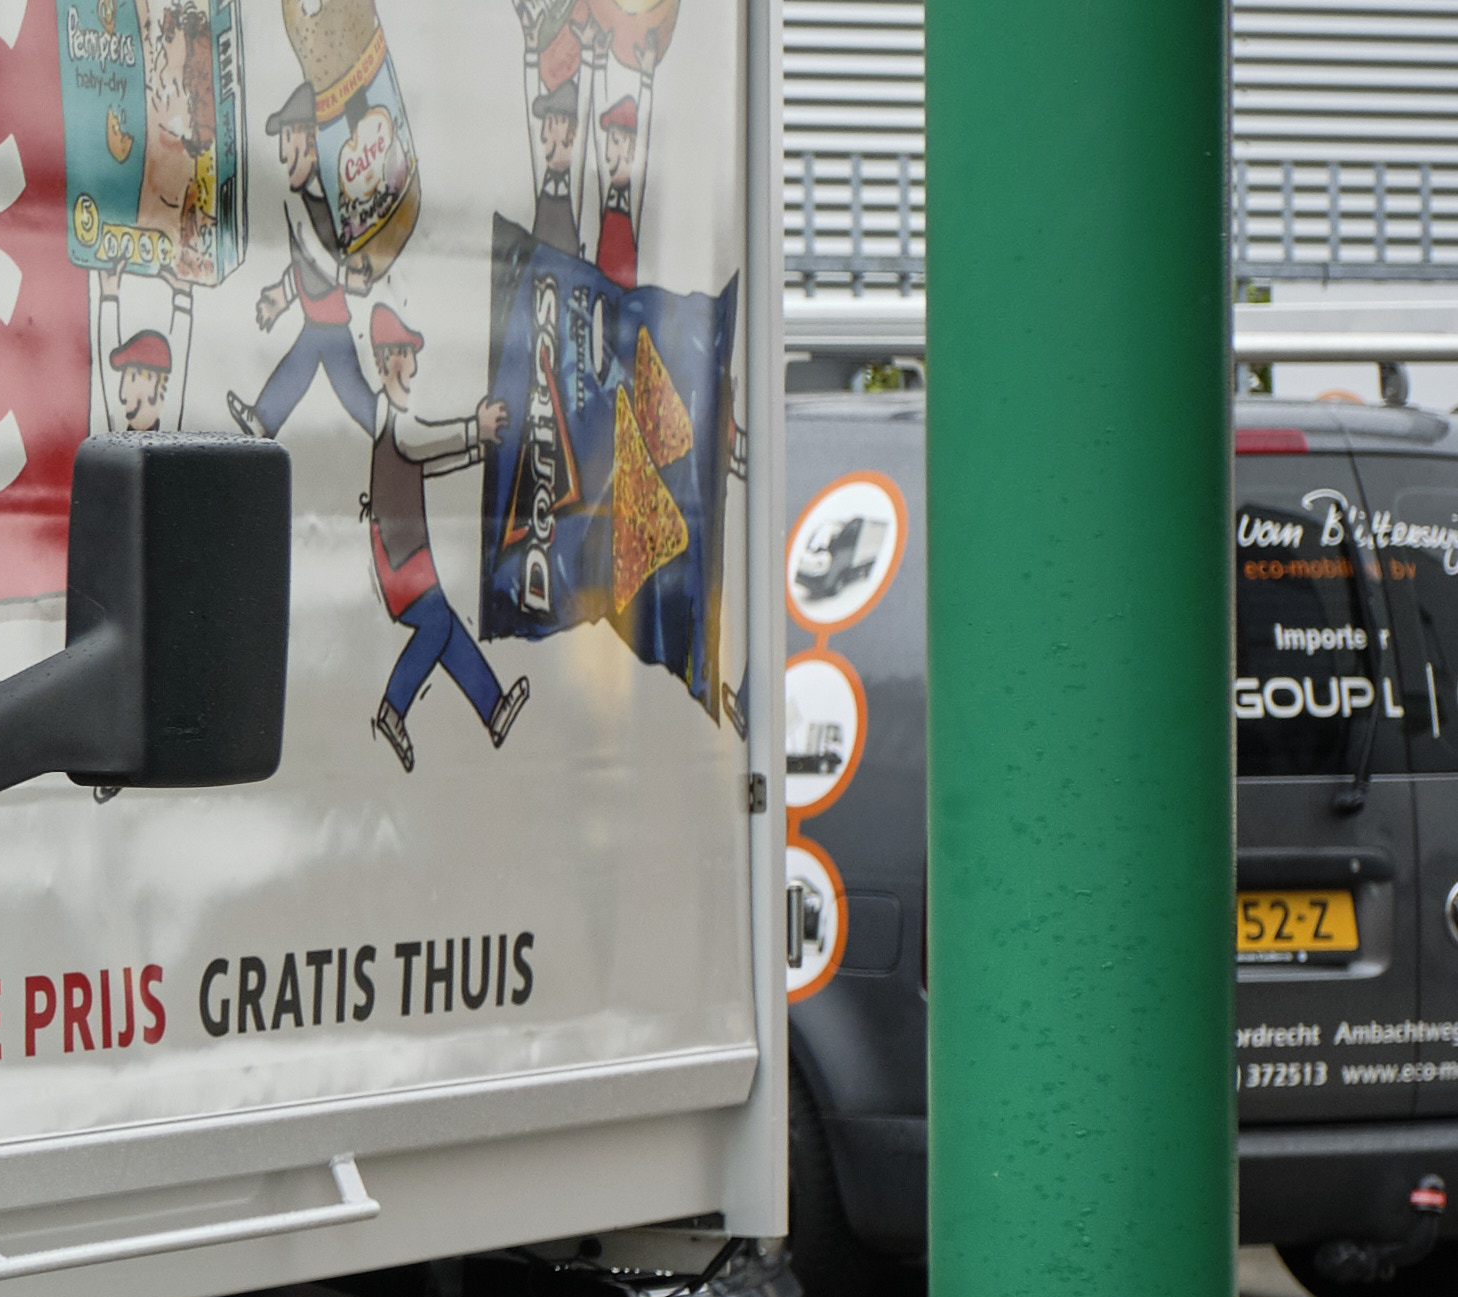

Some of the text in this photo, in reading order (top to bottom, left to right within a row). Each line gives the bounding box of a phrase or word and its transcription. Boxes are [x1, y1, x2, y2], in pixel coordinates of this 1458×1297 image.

[66, 4, 136, 73] Pampers
[344, 121, 385, 184] Calvé
[1273, 622, 1391, 656] Importer
[1235, 676, 1404, 719] GOUPL
[24, 963, 167, 1057] PRIJS
[199, 944, 377, 1038] GRATIS
[394, 930, 535, 1018] THUIS
[1244, 1060, 1329, 1089] 372513
